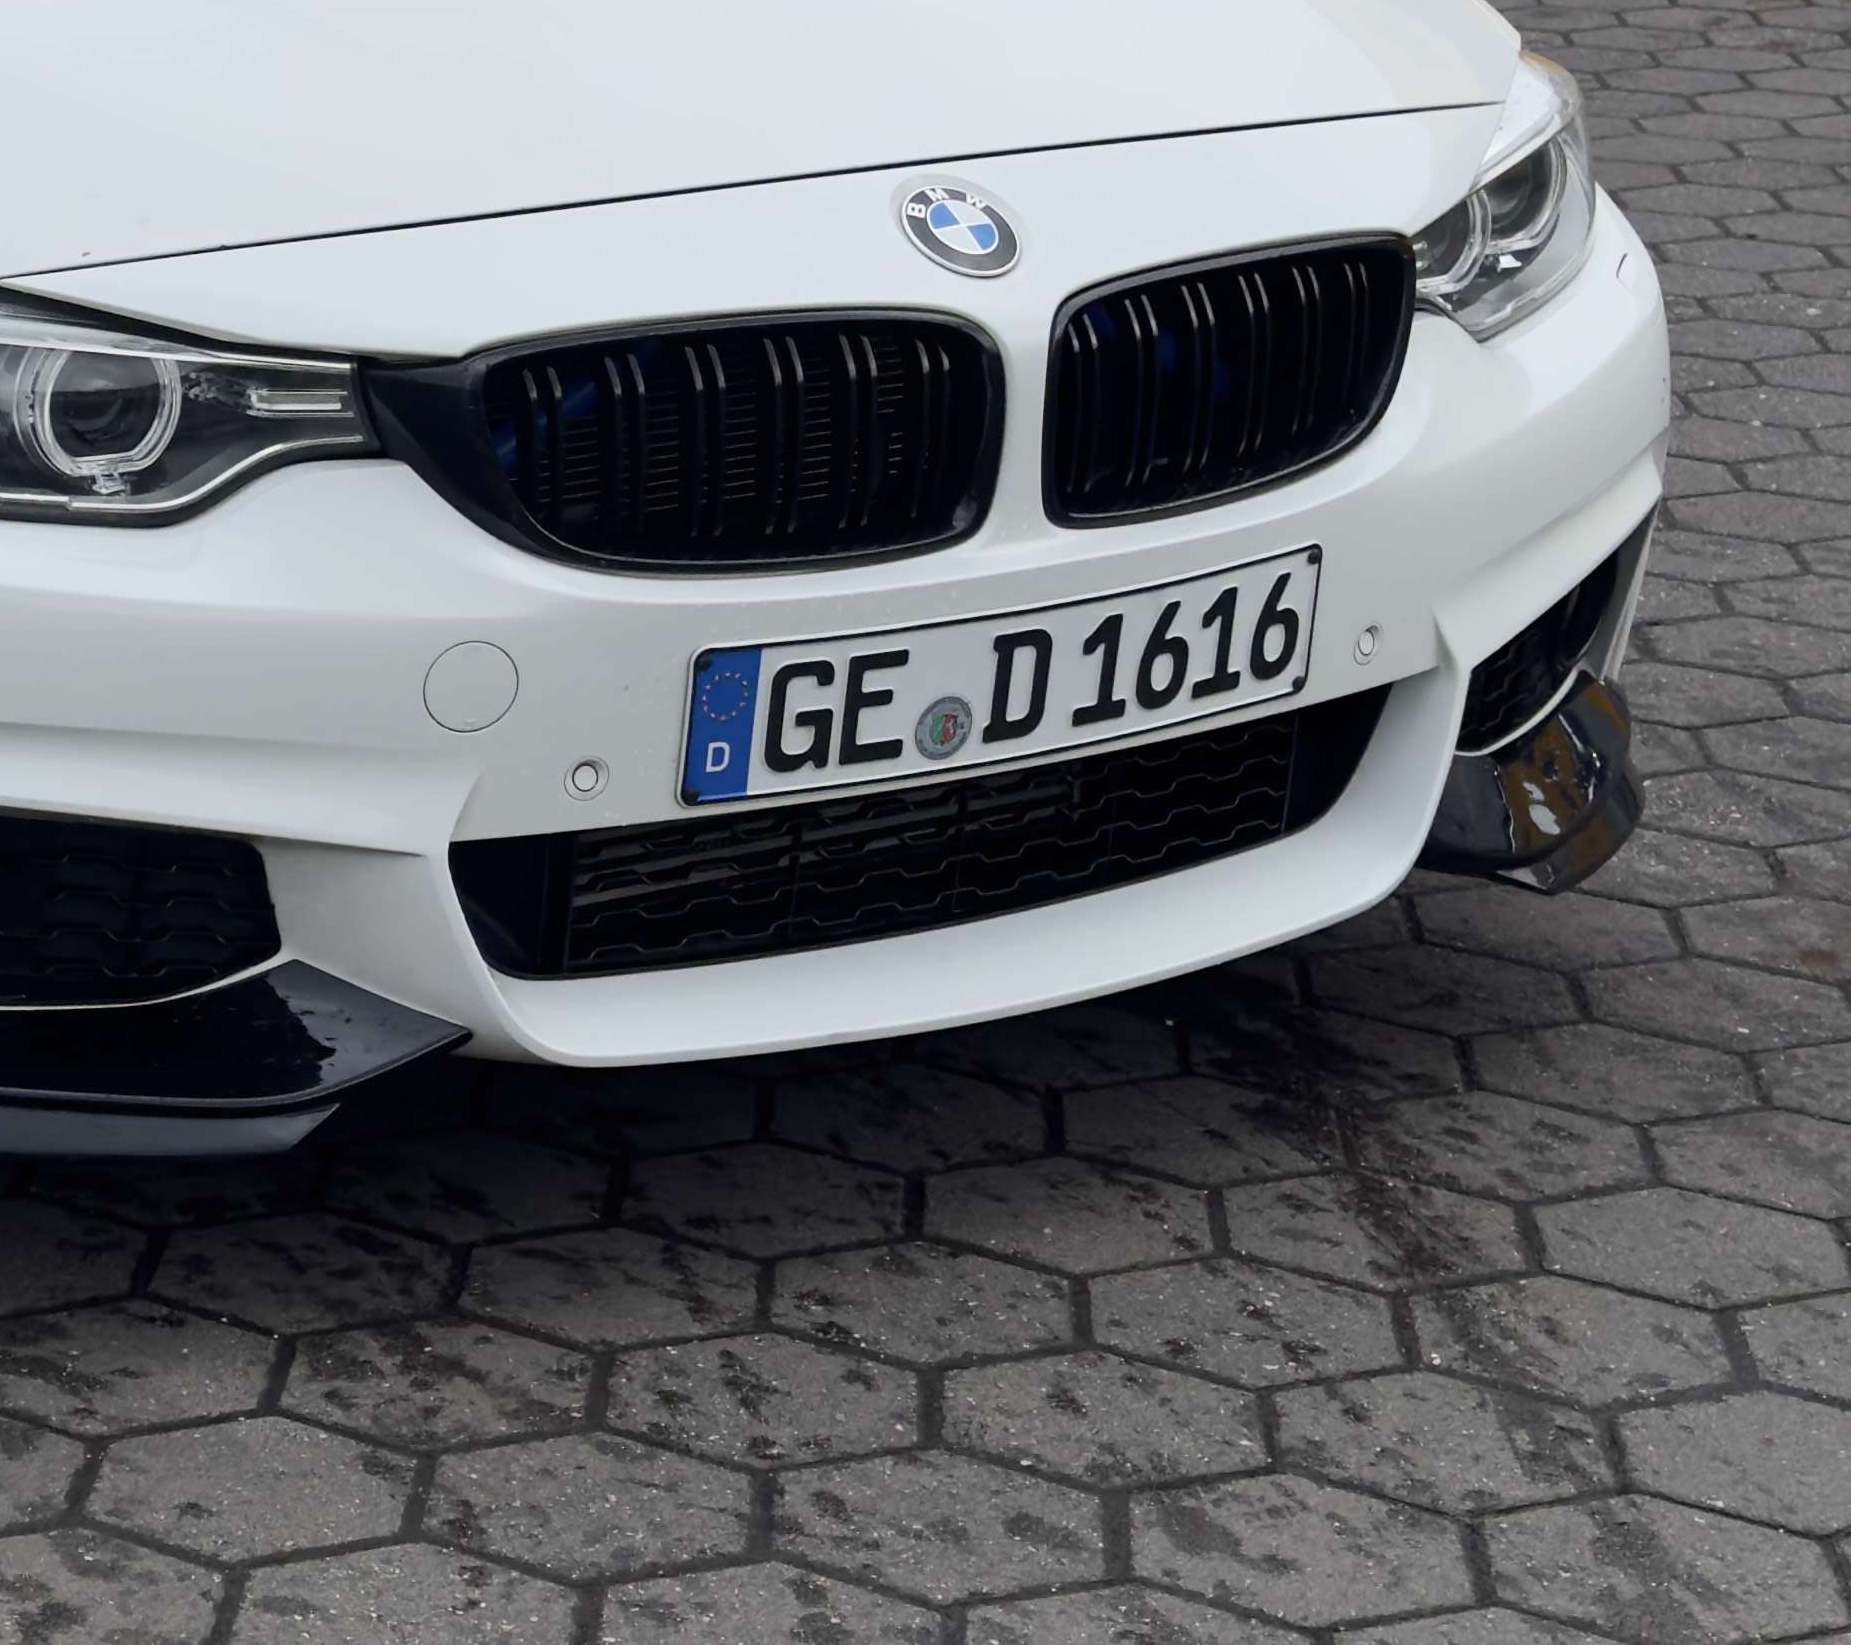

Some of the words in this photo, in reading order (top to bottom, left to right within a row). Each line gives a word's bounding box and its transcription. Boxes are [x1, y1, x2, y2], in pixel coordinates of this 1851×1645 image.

[906, 186, 989, 219] BMW
[761, 648, 911, 774] GE
[705, 741, 730, 774] D
